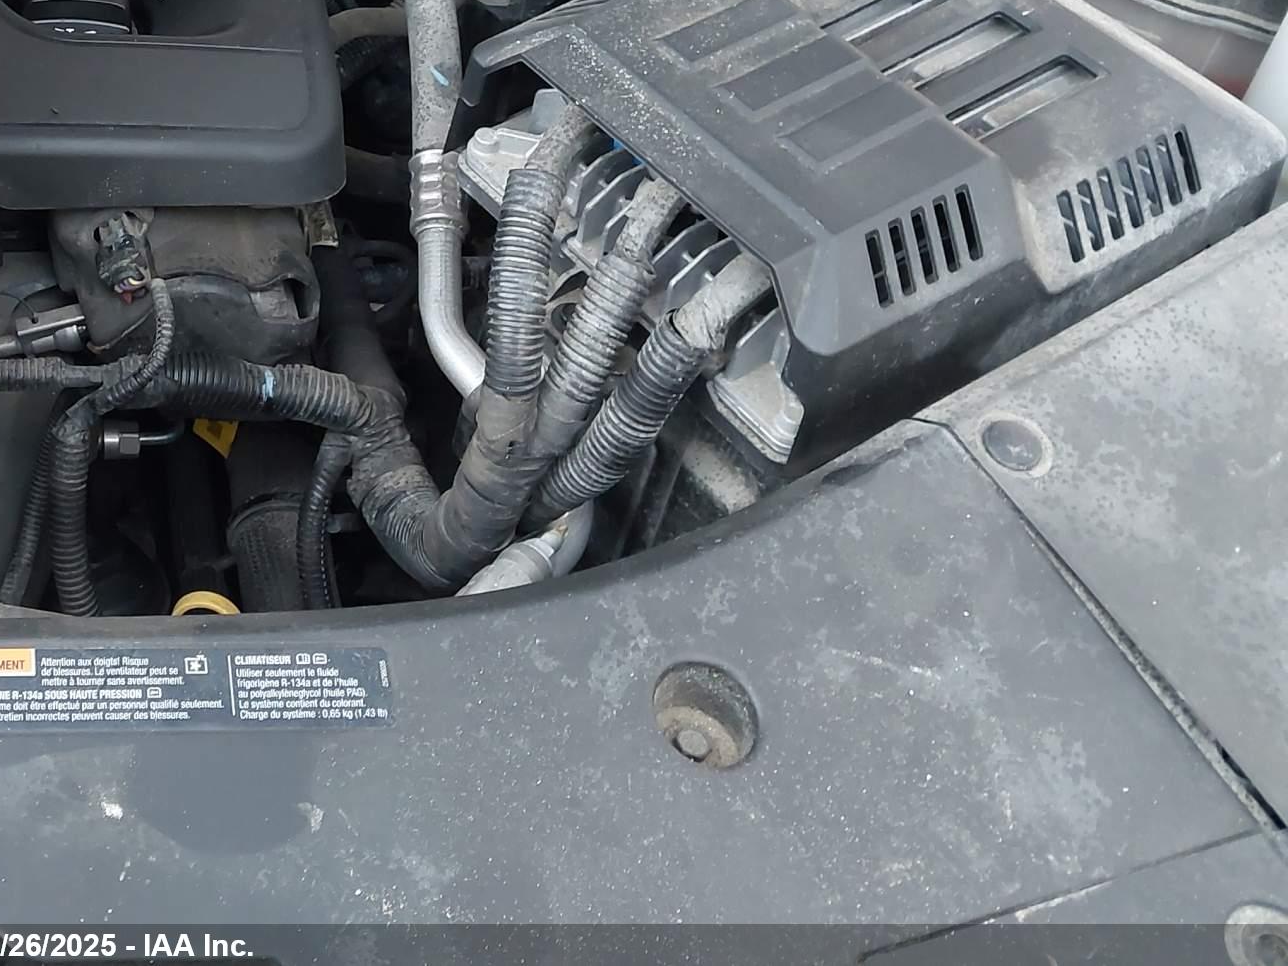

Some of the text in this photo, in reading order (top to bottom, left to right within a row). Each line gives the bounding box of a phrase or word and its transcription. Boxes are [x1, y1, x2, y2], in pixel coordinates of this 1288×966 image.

[41, 657, 75, 667] Attention
[122, 657, 148, 667] Risque
[235, 655, 291, 665] CLIMATISEUR
[41, 667, 52, 676] de
[53, 667, 93, 676] blessures.
[95, 667, 104, 676] Le
[106, 667, 147, 676] ventilateur
[150, 667, 167, 677] peut
[236, 668, 338, 677] Utiliser seulement le fluide
[12, 691, 43, 700] R-134a
[45, 690, 68, 699] SOUS
[70, 690, 97, 699] HAUTE
[100, 690, 142, 699] PRESSION
[239, 698, 366, 710] Le système contient du colorant.
[72, 713, 103, 722] peuvent
[106, 712, 131, 721] causer
[134, 712, 148, 721] des
[150, 712, 191, 720] blessures.
